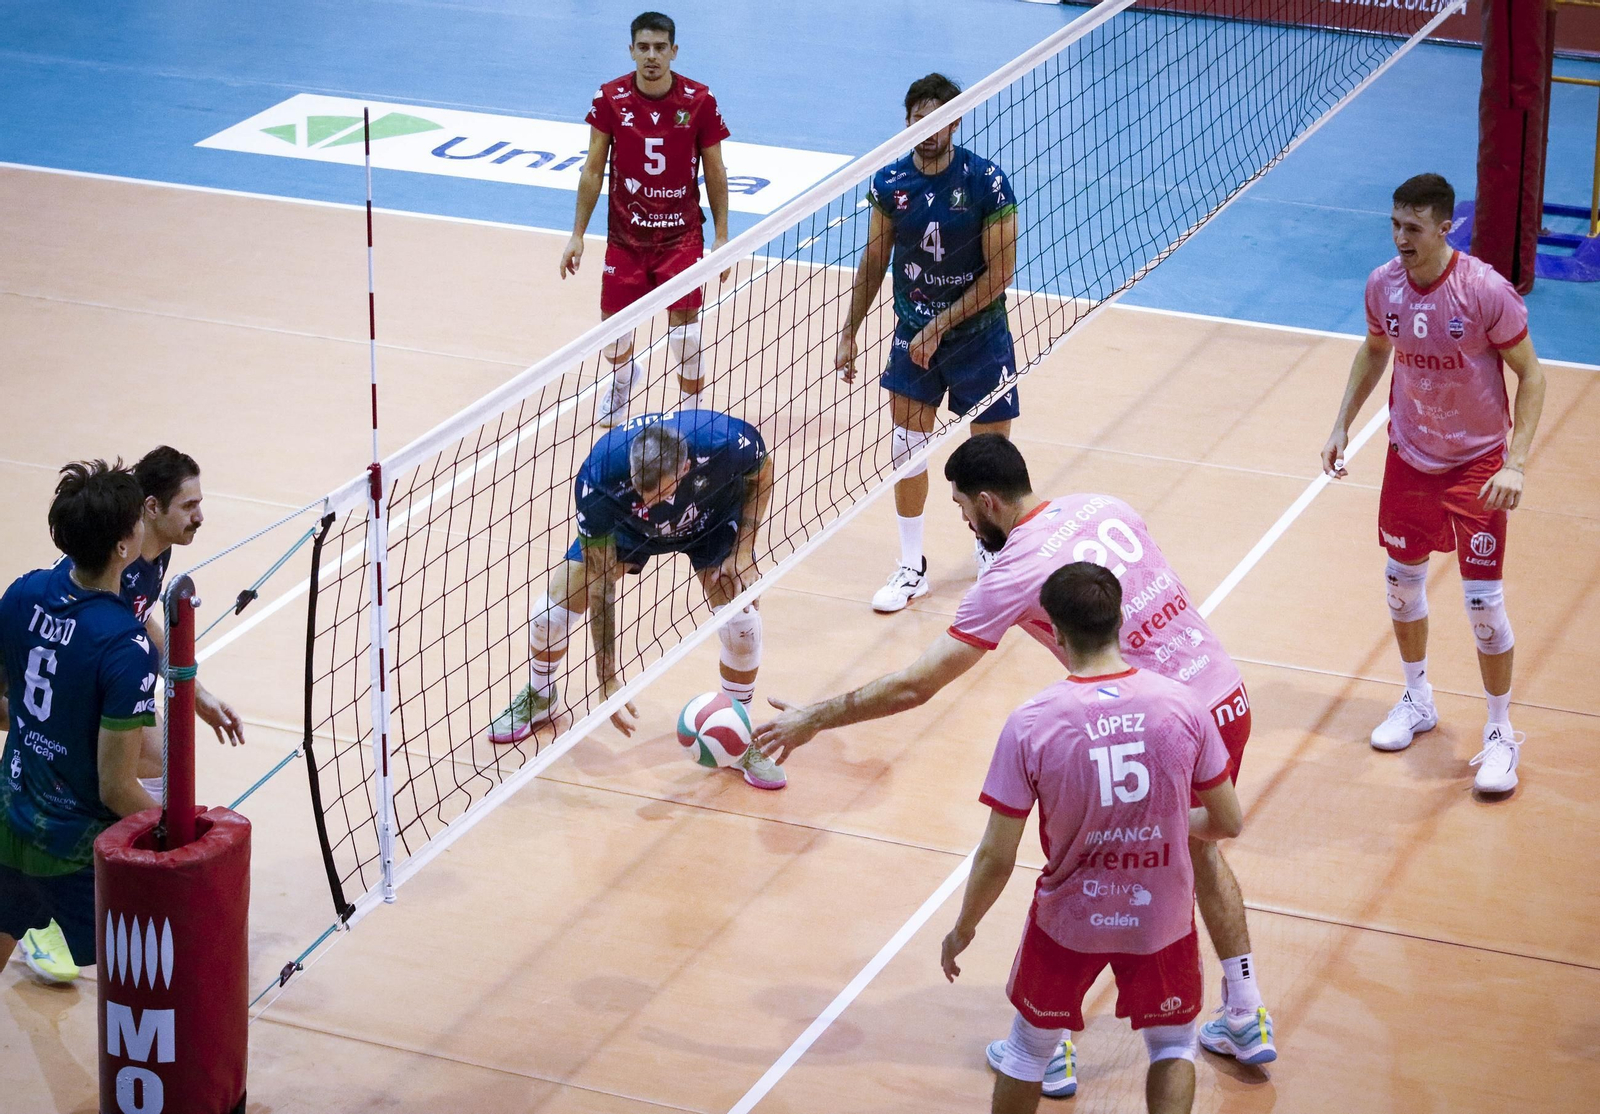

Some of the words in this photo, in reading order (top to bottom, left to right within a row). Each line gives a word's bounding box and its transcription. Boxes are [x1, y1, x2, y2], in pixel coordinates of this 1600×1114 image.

[644, 137, 666, 176] 5
[644, 186, 687, 199] Unicaja
[920, 221, 946, 262] 4
[924, 273, 974, 287] Unicaja
[1413, 312, 1428, 339] 6
[1396, 350, 1465, 370] arenal
[1037, 519, 1082, 558] VICTOR
[1073, 518, 1143, 579] 20
[1466, 556, 1497, 566] LEGEA
[23, 645, 58, 722] 6
[1085, 713, 1145, 741] LÓPEZ
[1089, 740, 1150, 807] 15
[1090, 912, 1139, 927] Galén
